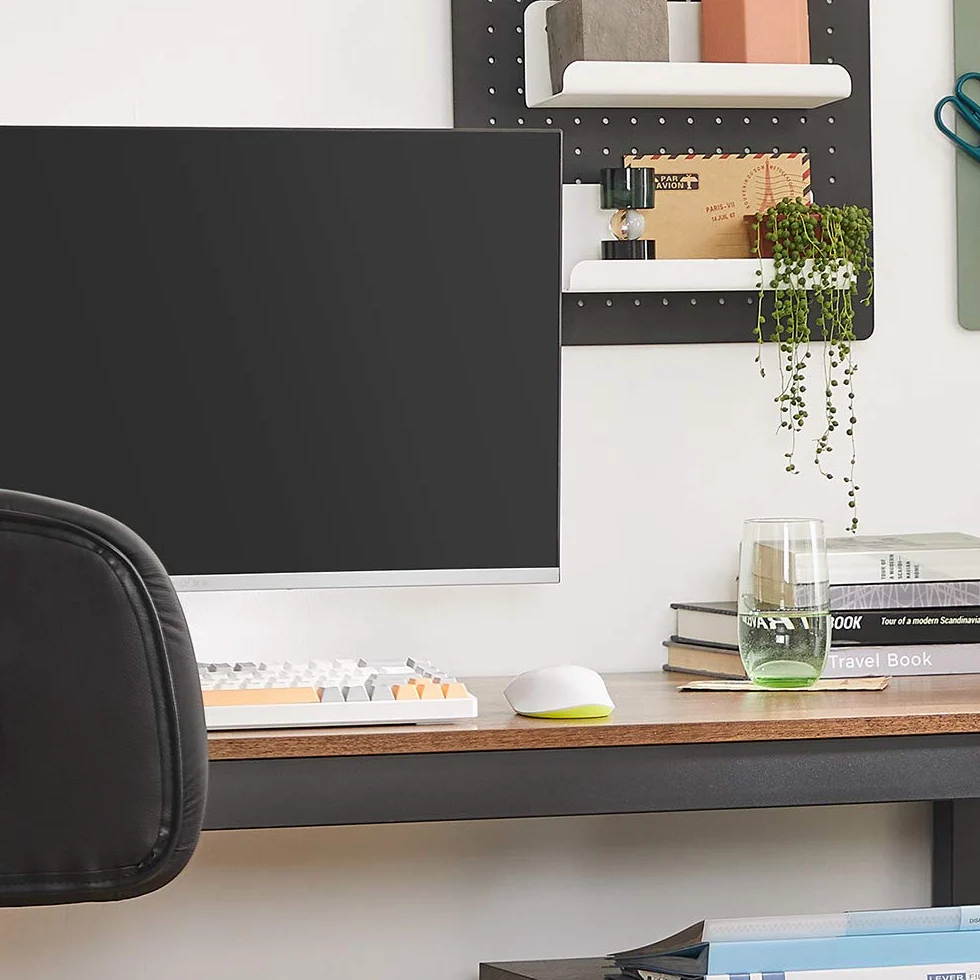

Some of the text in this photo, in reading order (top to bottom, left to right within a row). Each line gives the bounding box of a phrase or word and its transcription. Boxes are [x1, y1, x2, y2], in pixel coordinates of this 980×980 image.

[881, 617, 896, 625] Tour
[898, 616, 906, 625] of
[912, 616, 938, 624] modern
[828, 652, 932, 668] Travel Book
